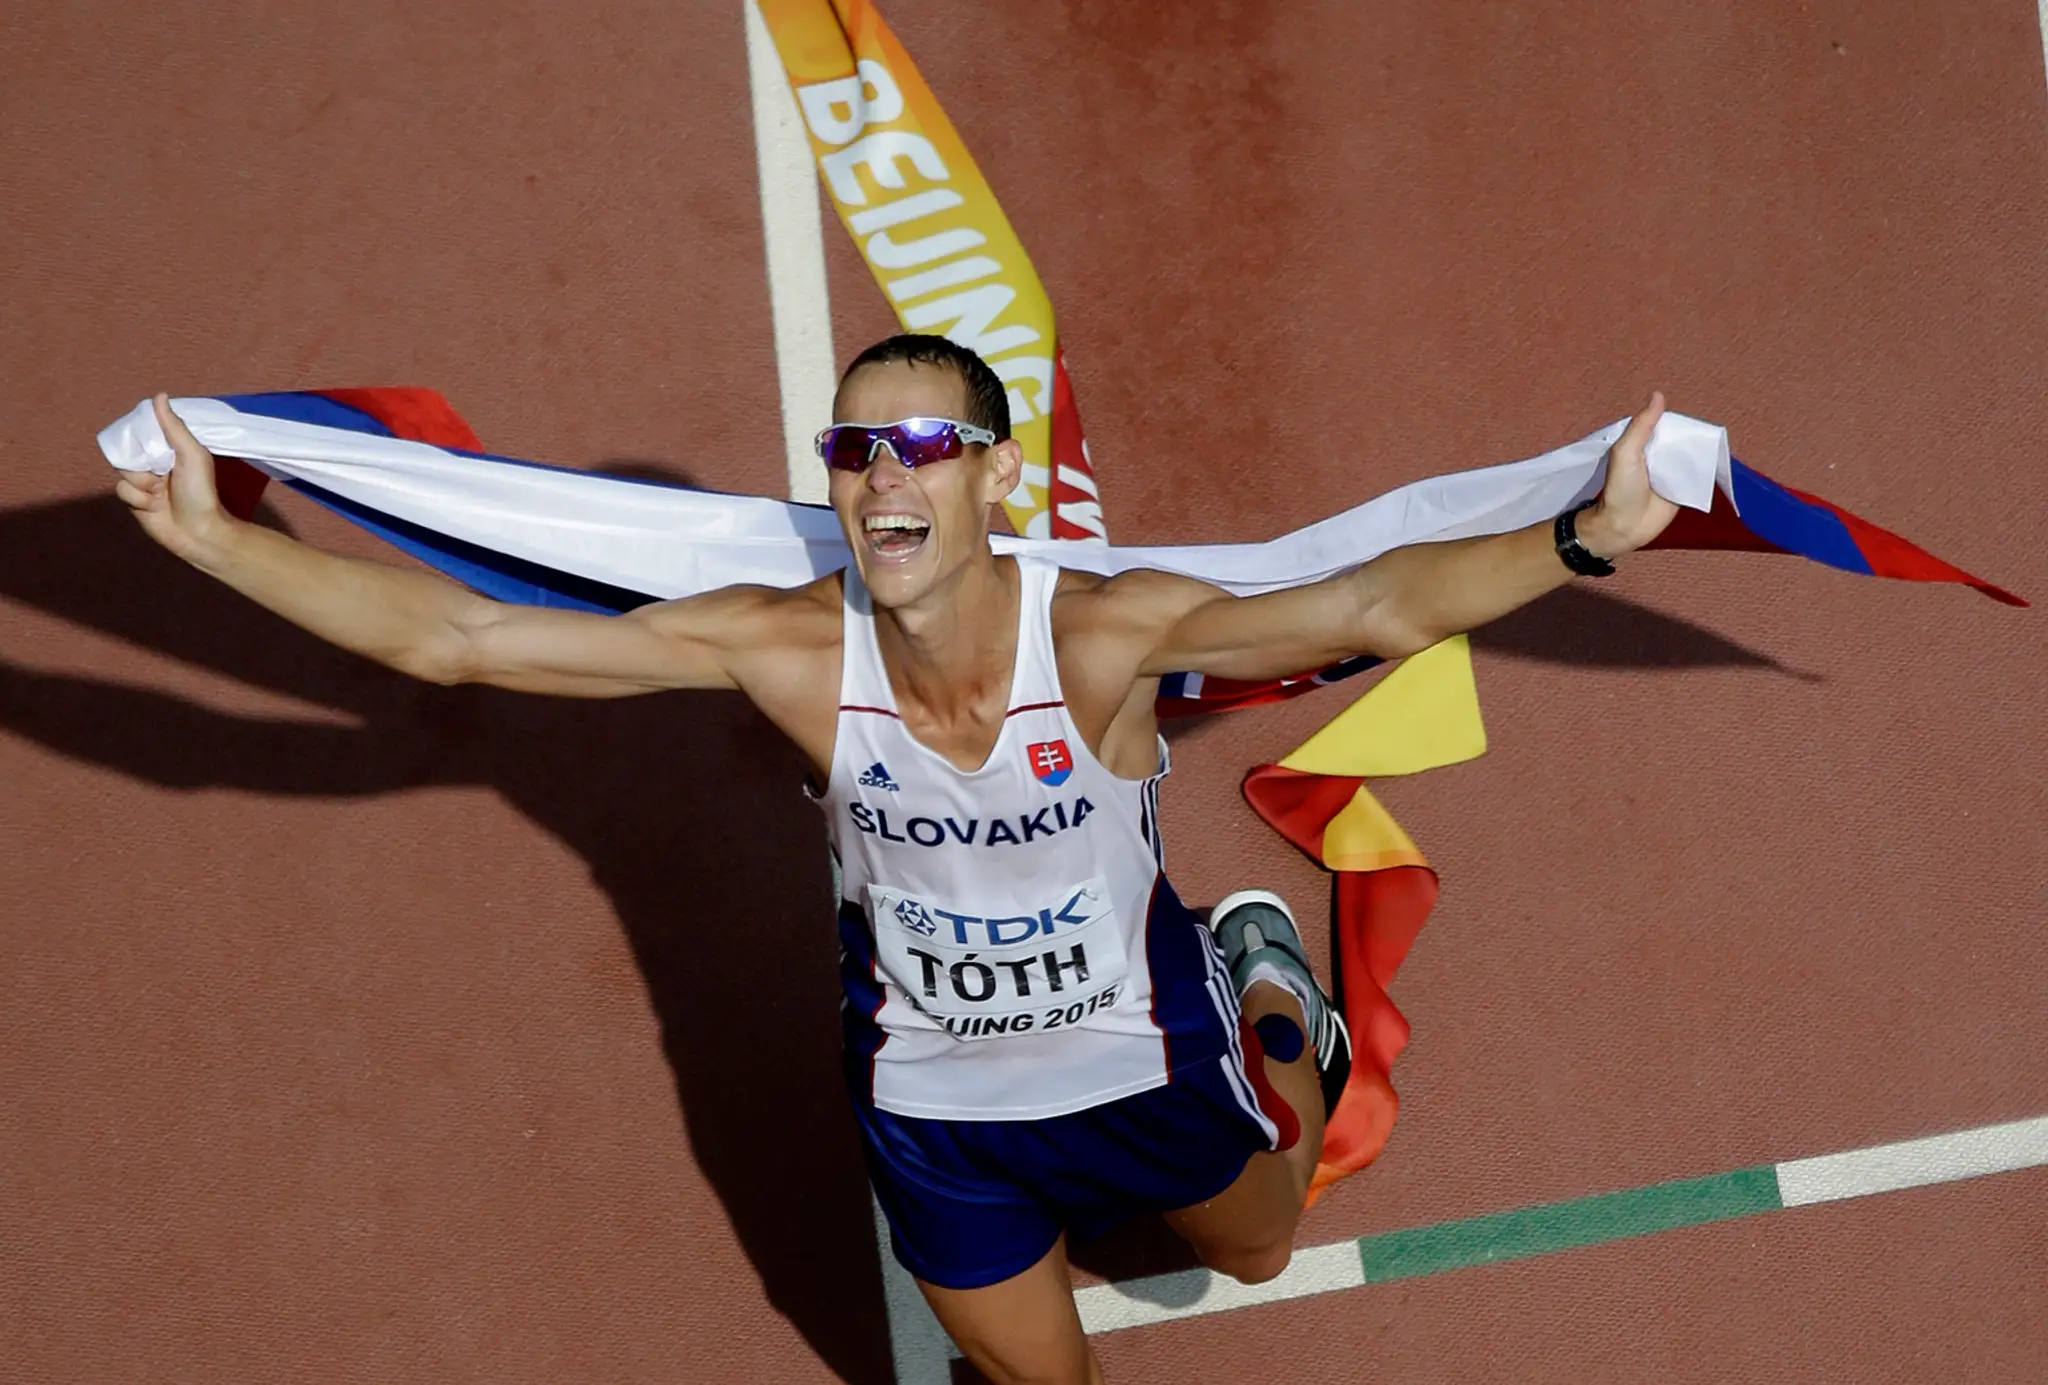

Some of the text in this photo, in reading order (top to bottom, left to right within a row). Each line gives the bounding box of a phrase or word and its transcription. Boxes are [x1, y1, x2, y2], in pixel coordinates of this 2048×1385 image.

[858, 776, 900, 792] adidas
[849, 797, 1095, 847] SLOVAKIA
[934, 892, 1092, 946] TDK
[906, 943, 1090, 1003] TÓTH
[929, 984, 1116, 1037] IJING 2015
